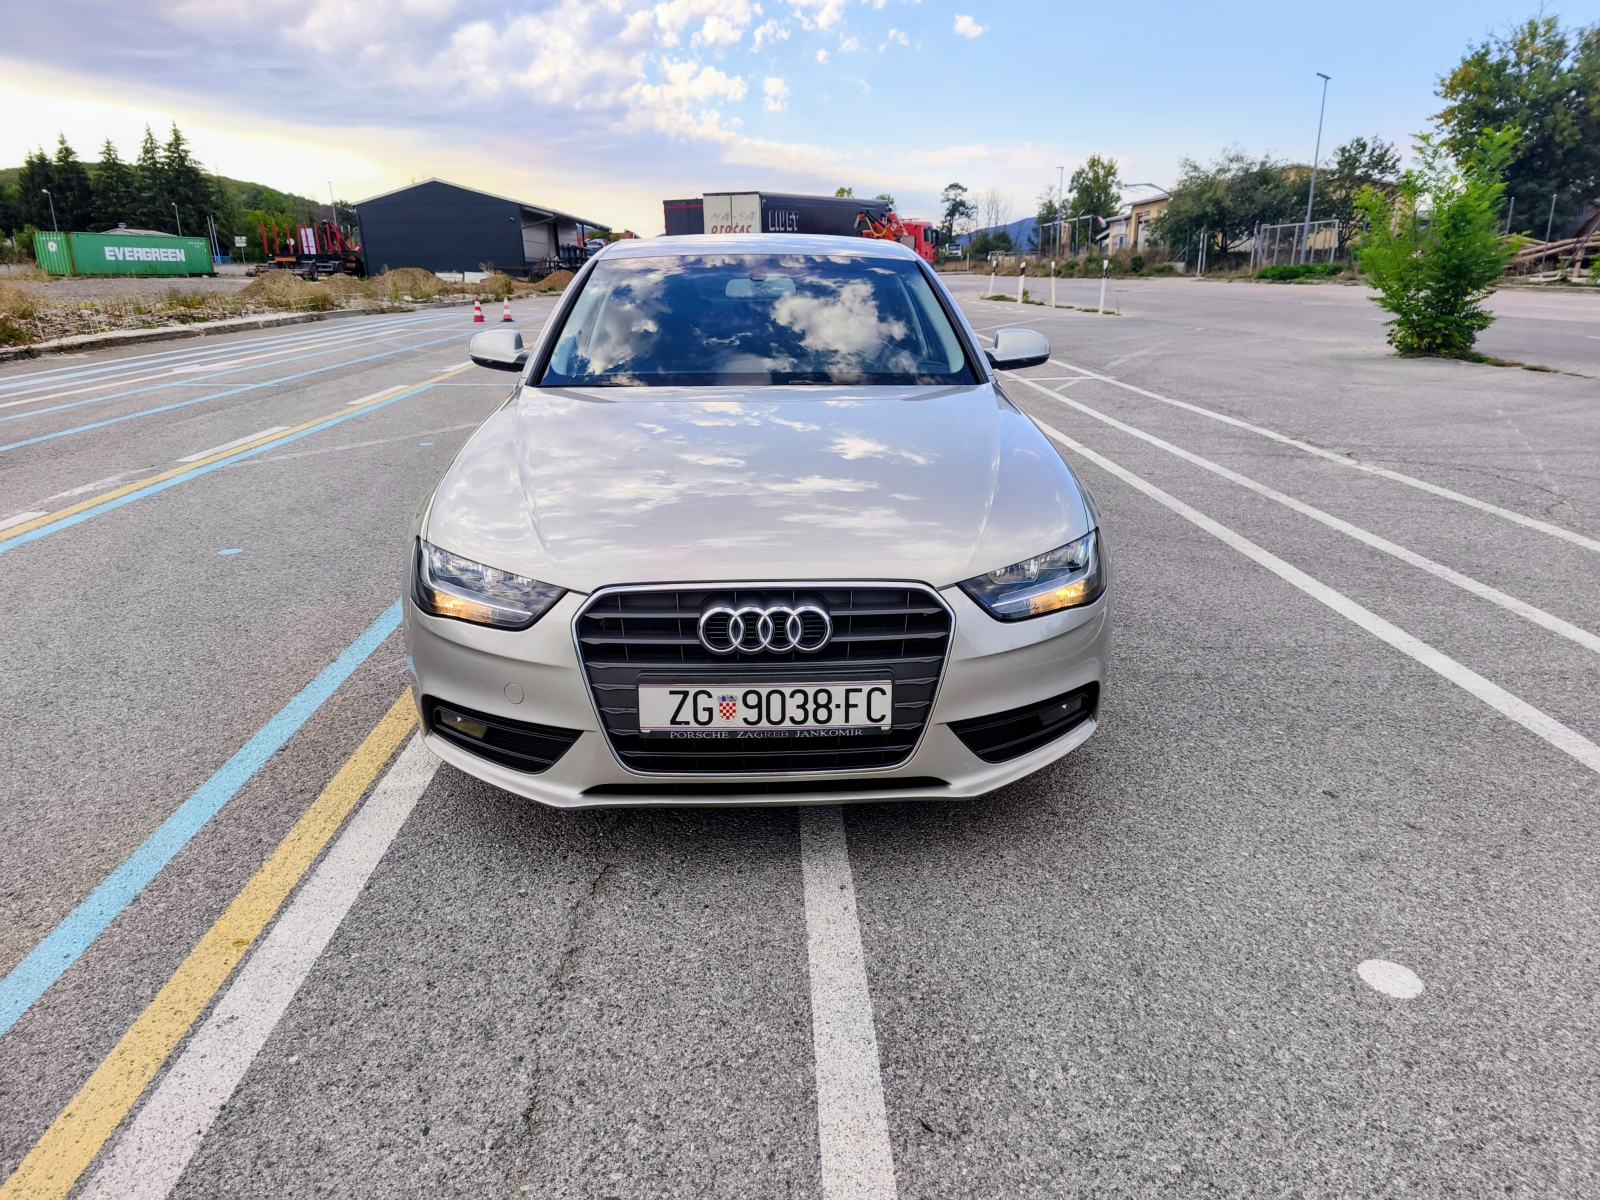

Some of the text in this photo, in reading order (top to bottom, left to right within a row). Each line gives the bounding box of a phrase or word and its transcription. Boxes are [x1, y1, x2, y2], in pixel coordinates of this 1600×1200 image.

[104, 246, 186, 262] EVERGREEN
[669, 689, 714, 726] ZG
[670, 729, 864, 739] PORSCHE ZAGREB JANKOMIR
